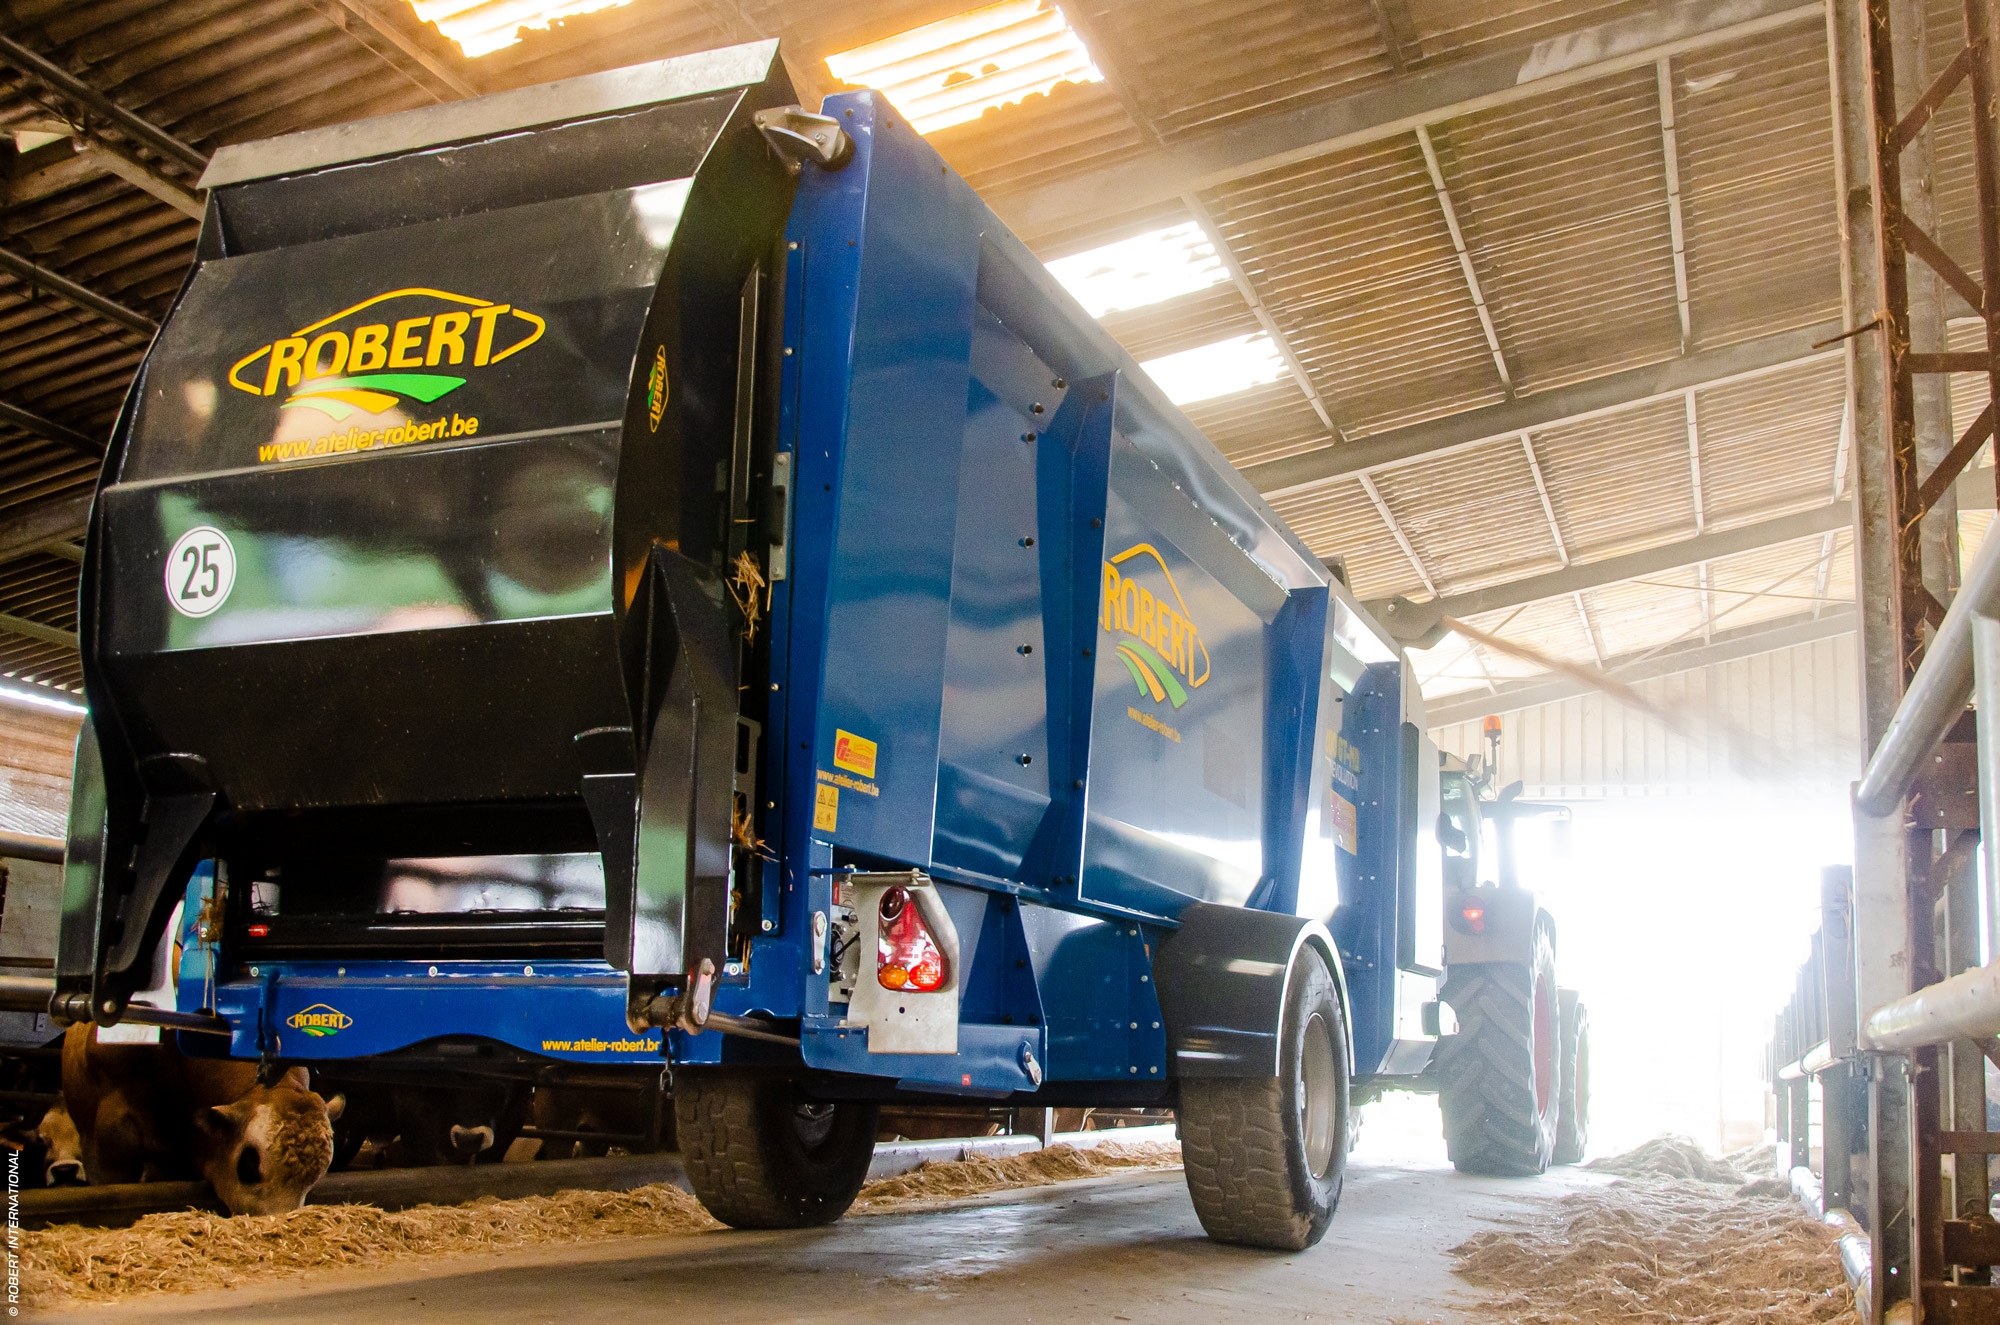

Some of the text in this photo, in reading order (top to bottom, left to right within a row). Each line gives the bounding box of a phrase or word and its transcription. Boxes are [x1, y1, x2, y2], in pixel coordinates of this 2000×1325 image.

[263, 303, 511, 396] ROBERT
[650, 353, 666, 422] ROBERT
[258, 413, 479, 462] www.atelier-robert.be
[180, 543, 221, 600] 25
[1104, 561, 1197, 688] ROBERT
[294, 1013, 345, 1029] ROBERT
